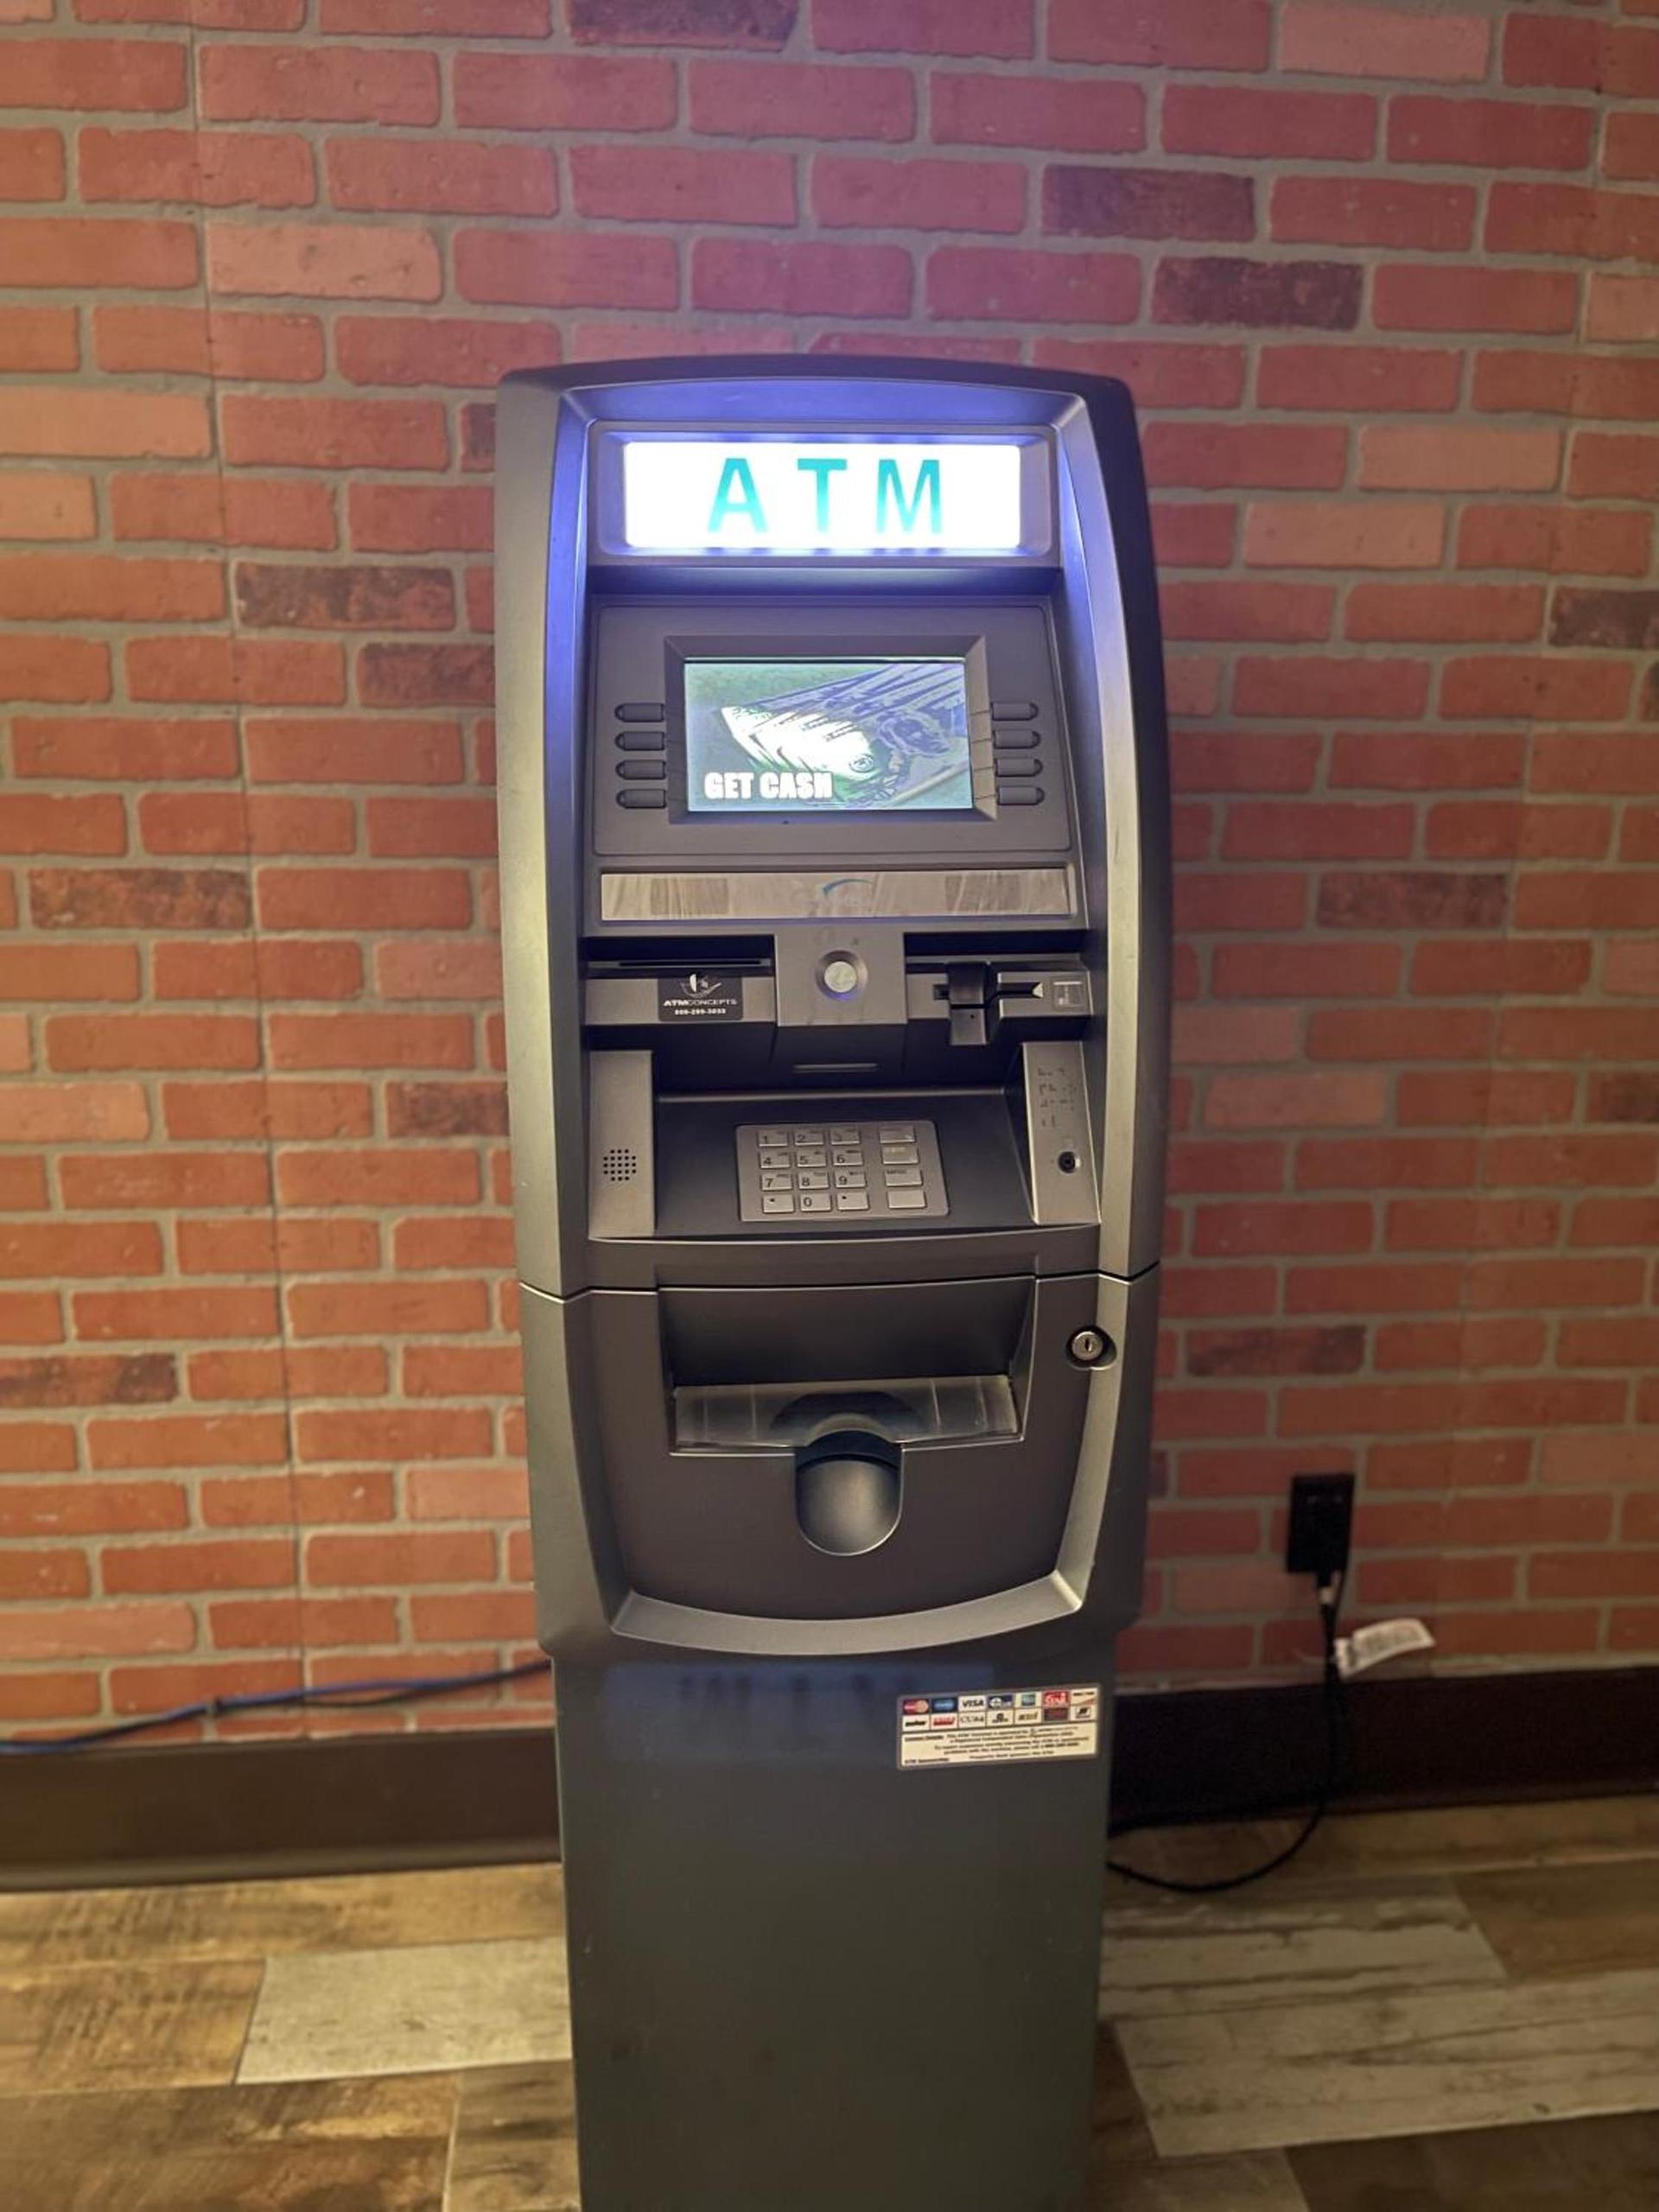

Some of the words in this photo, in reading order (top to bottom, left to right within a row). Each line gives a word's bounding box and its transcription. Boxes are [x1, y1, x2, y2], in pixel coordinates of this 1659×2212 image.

[707, 457, 942, 533] ATM
[704, 772, 753, 798] GET
[760, 772, 833, 798] CASH
[800, 1156, 808, 1165] 5
[836, 1154, 845, 1163] 6
[766, 1178, 773, 1187] 7
[802, 1178, 810, 1186] 8
[838, 1176, 847, 1185] 9
[804, 1197, 812, 1206] 0
